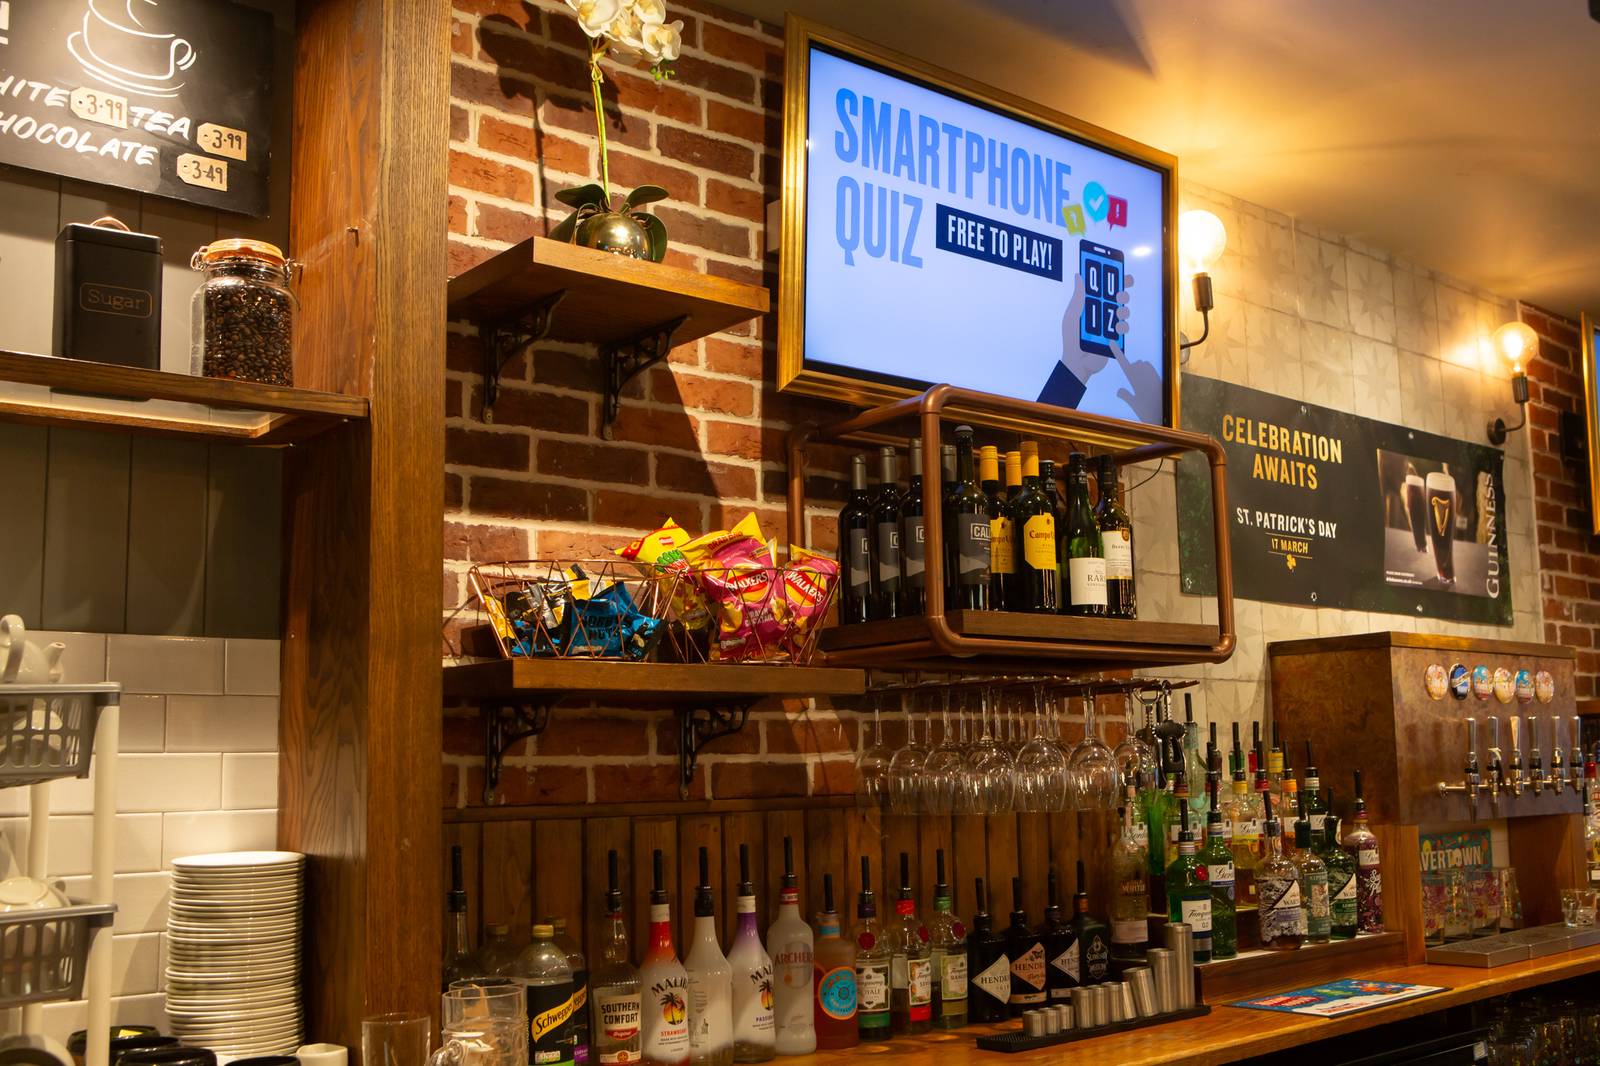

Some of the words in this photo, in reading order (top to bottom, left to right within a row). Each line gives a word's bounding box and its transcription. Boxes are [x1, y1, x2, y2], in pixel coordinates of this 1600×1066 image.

[129, 106, 190, 140] TEA
[834, 88, 1072, 228] SMARTPHONE
[835, 175, 923, 269] QUIZ
[947, 213, 985, 252] FREE
[989, 225, 1008, 259] TO
[1013, 232, 1053, 271] PLAY!
[1089, 266, 1099, 292] Q
[1107, 272, 1115, 296] U
[87, 287, 145, 311] Sugar
[1222, 414, 1342, 464] CELEBRATION
[1252, 453, 1318, 490] AWAITS
[1236, 507, 1254, 526] ST.
[1256, 510, 1316, 536] PATRICK'S
[1318, 521, 1337, 539] DAY
[1485, 473, 1500, 599] GUINNESS
[1271, 538, 1279, 549] 17
[1280, 540, 1309, 554] MARCH
[725, 570, 769, 592] WALKERS
[789, 570, 825, 605] WALKERS
[601, 1001, 640, 1015] SOUTHERN
[603, 1013, 638, 1025] COMFORT
